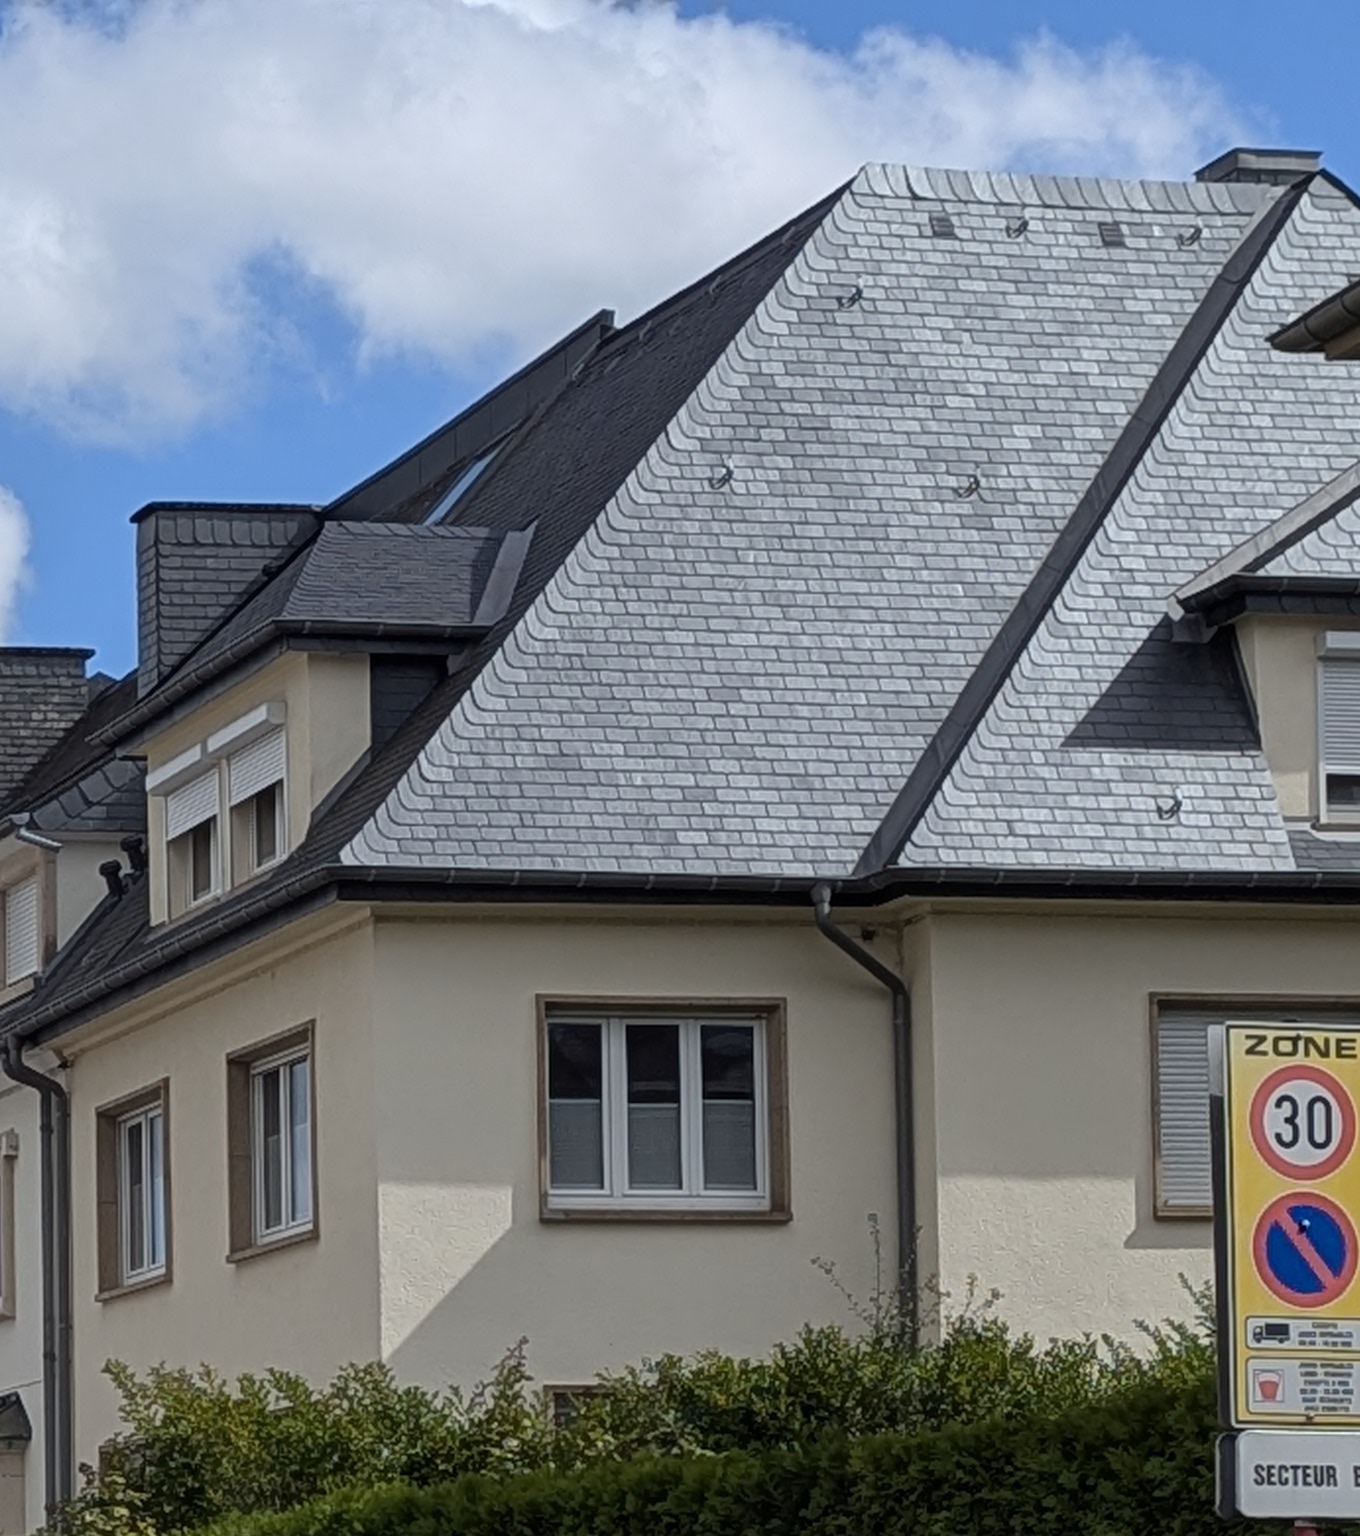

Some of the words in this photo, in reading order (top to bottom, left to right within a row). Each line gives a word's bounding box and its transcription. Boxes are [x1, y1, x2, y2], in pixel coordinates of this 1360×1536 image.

[1244, 1034, 1358, 1059] ZONE
[1274, 1094, 1333, 1150] 30
[1252, 1464, 1339, 1488] SECTEUR
